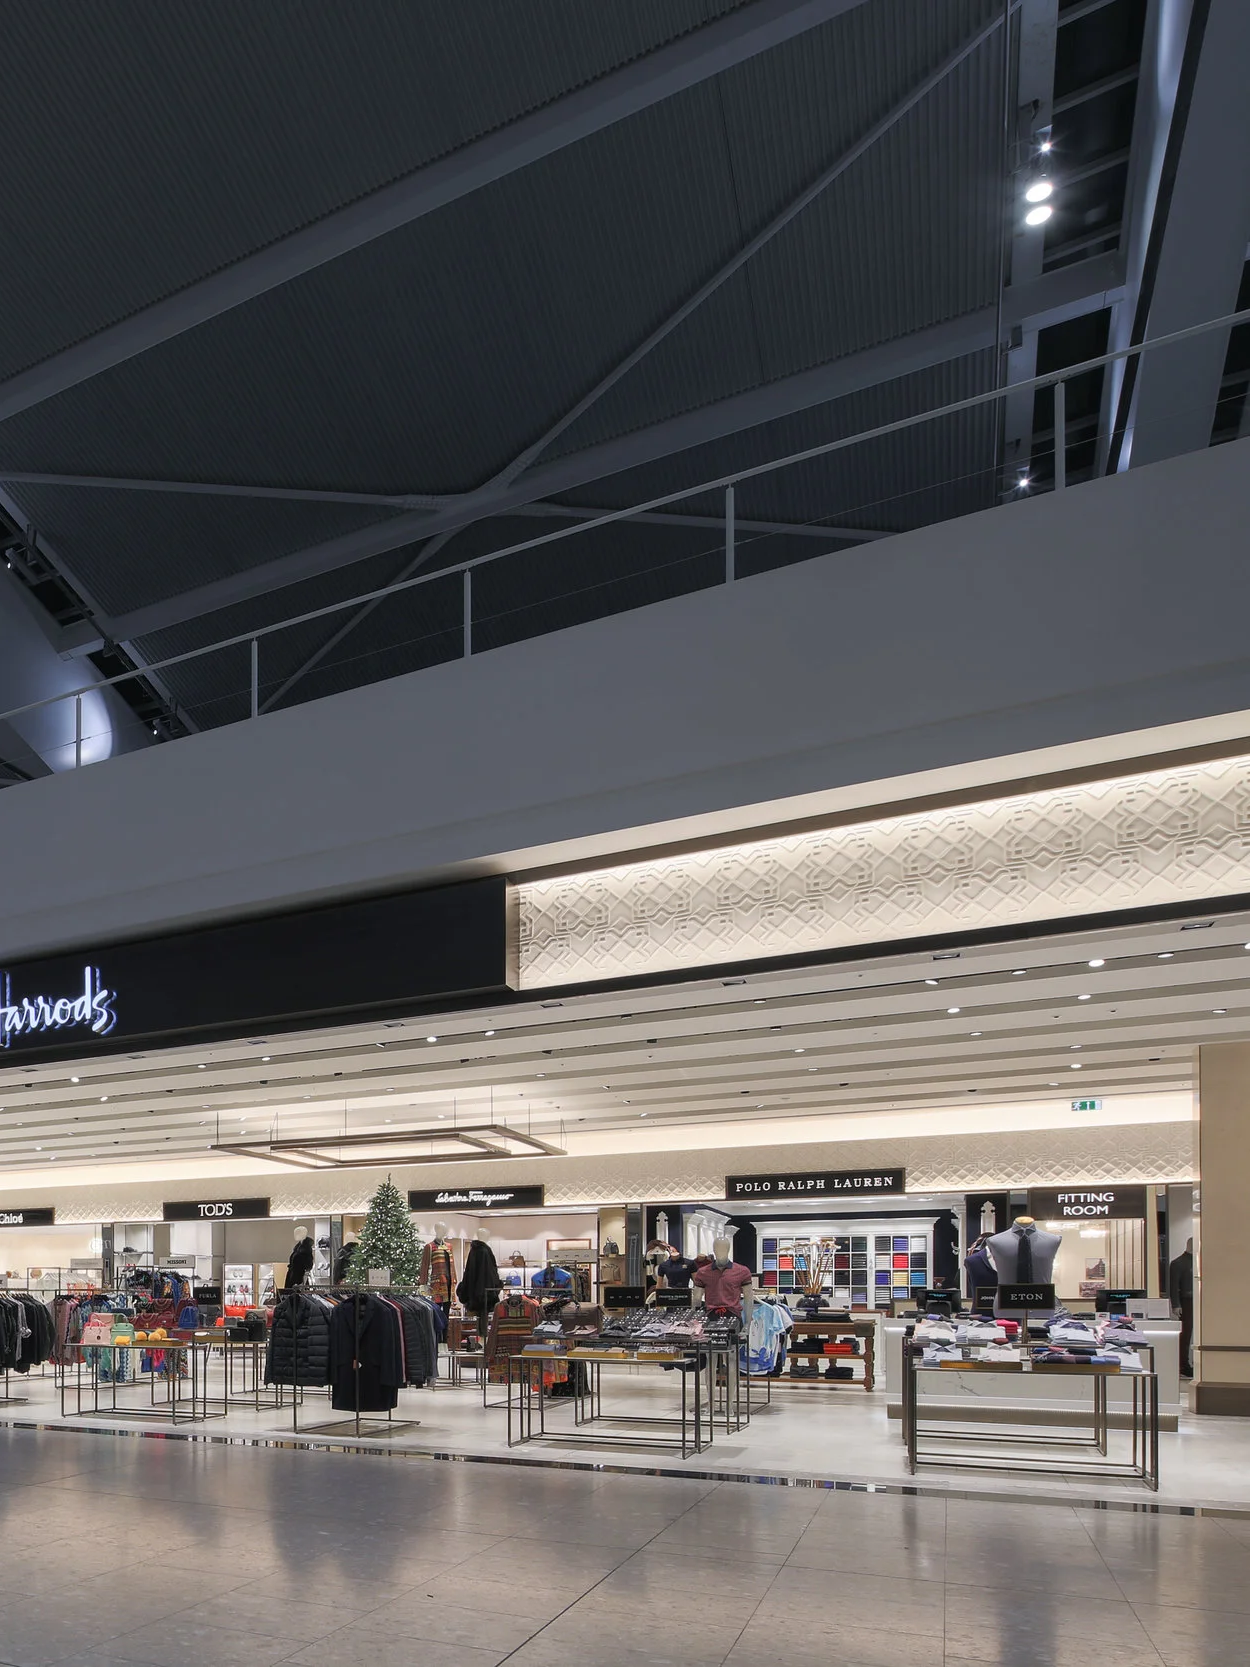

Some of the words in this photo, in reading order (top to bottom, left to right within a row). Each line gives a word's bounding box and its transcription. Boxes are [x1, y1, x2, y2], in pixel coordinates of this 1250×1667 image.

[735, 1181, 772, 1193] POLO
[777, 1179, 826, 1191] RALPH
[833, 1176, 895, 1189] LAUREN
[1057, 1192, 1115, 1204] FITTING
[197, 1202, 233, 1217] TOD'S
[1063, 1205, 1109, 1216] ROOM
[1010, 1293, 1044, 1301] ETON
